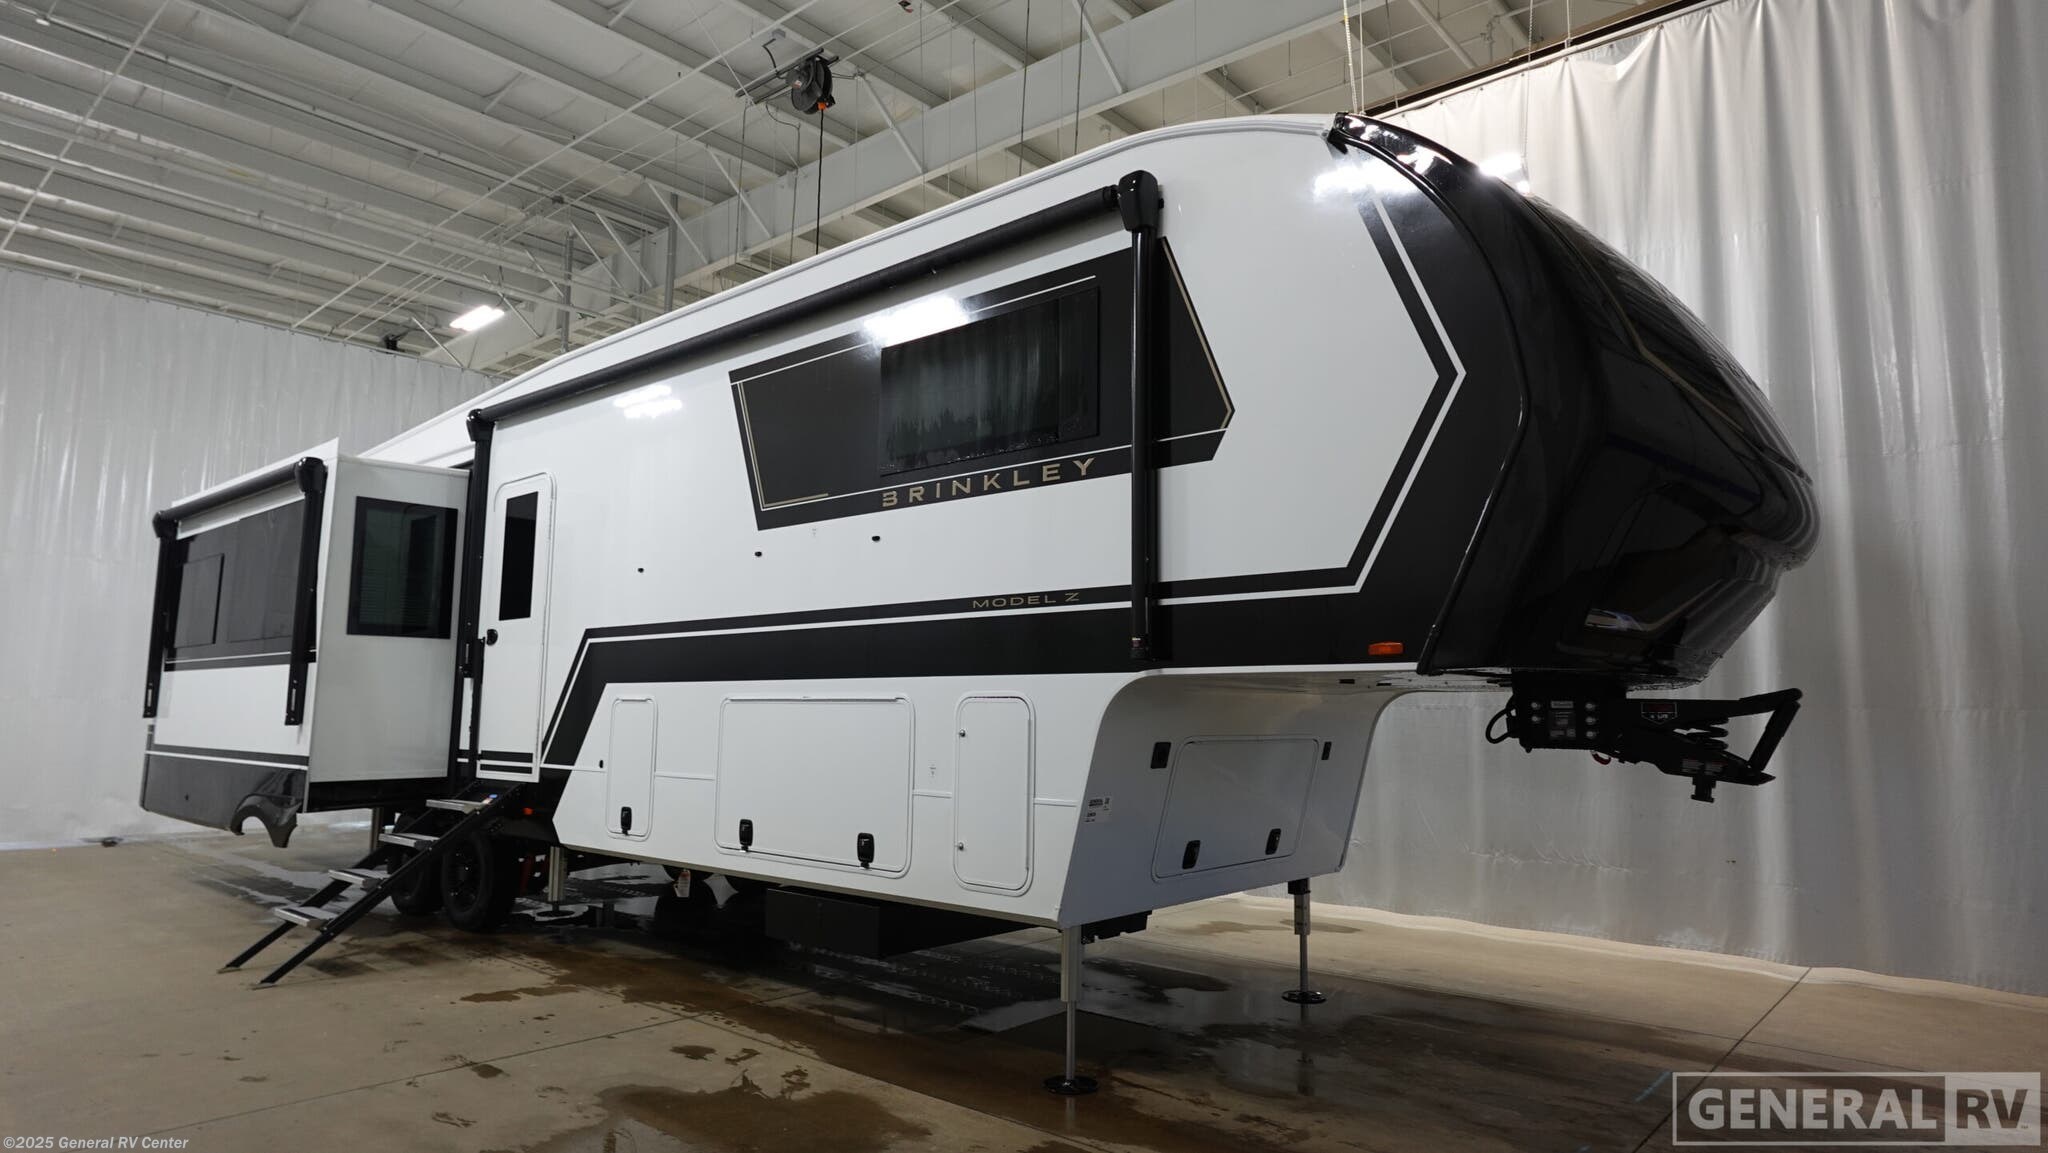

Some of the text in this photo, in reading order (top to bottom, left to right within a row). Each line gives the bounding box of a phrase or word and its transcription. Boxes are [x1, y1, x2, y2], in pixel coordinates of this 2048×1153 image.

[882, 457, 1095, 508] BRINKLEY
[972, 592, 1080, 609] MODEL Z
